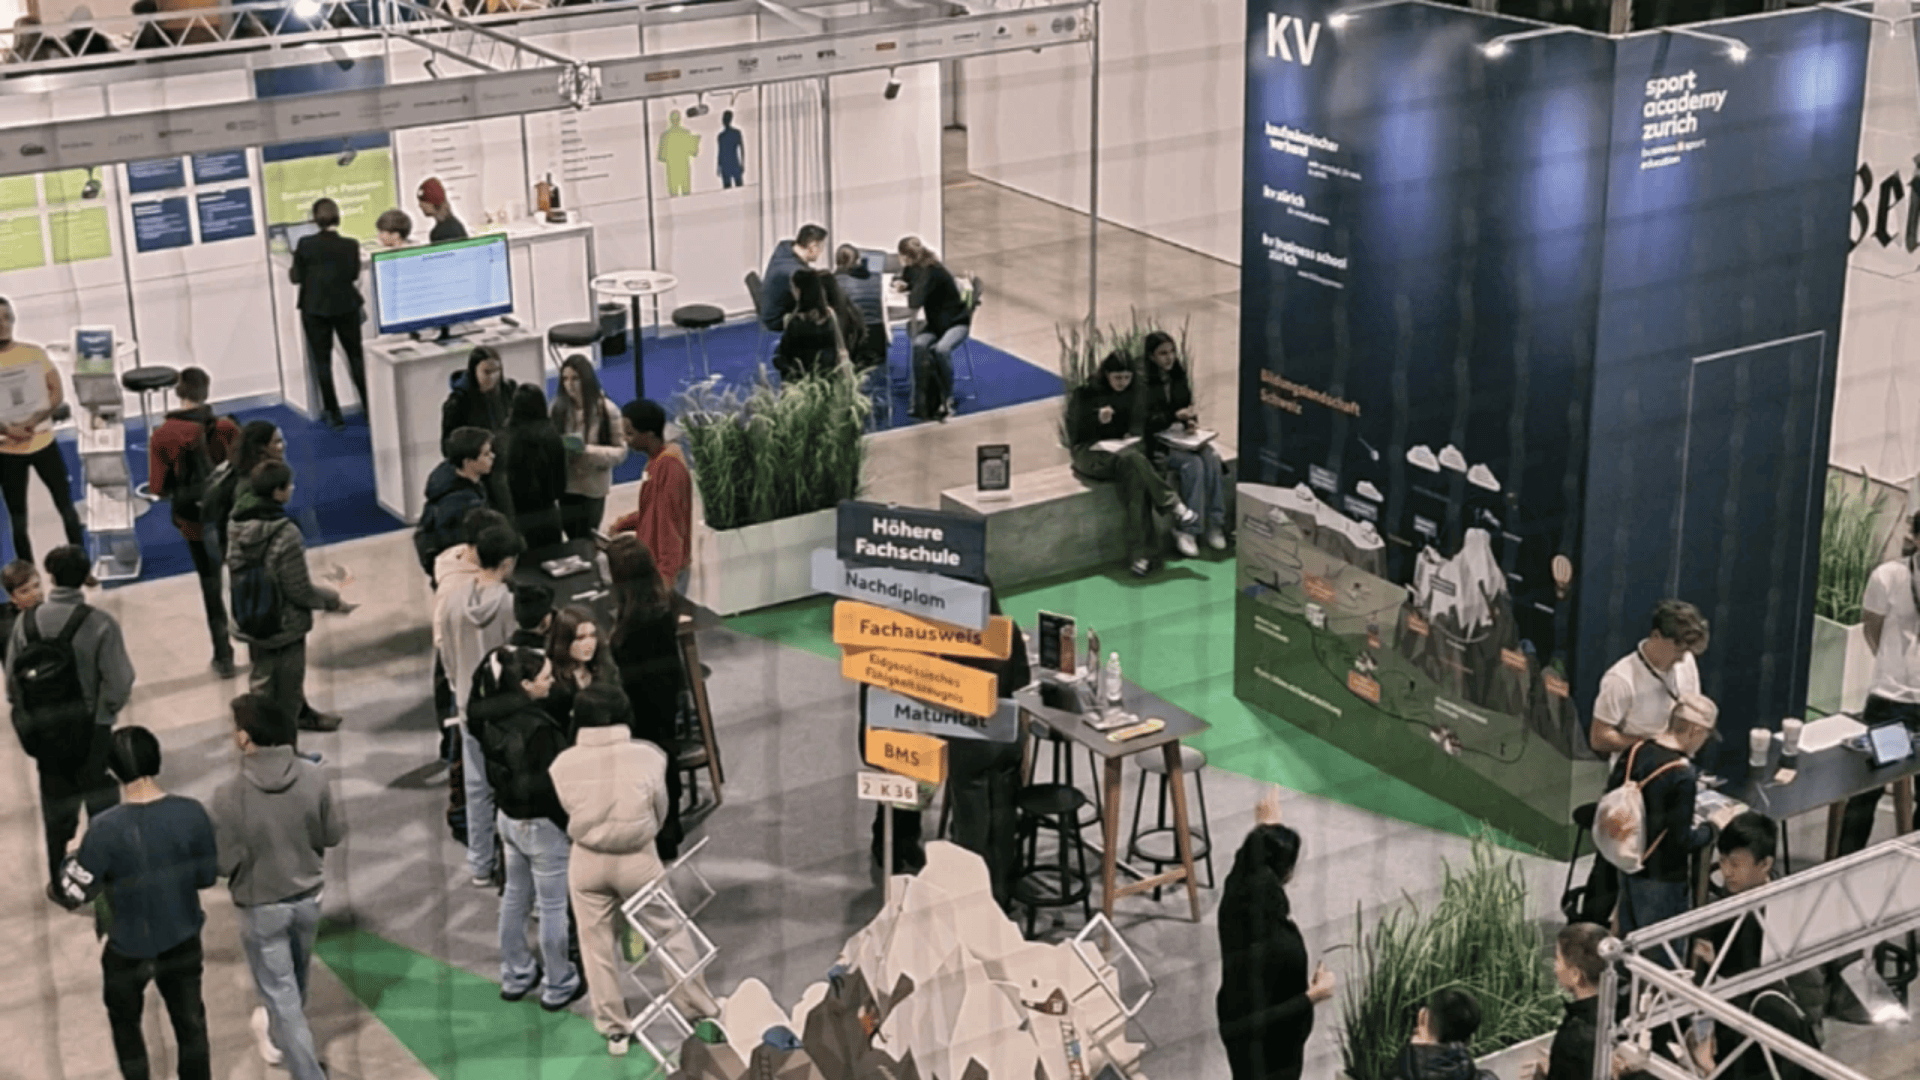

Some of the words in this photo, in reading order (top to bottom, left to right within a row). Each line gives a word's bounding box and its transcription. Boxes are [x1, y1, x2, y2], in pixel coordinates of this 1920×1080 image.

[1267, 12, 1320, 66] KV
[1645, 70, 1697, 99] sport
[1643, 90, 1727, 117] academy
[1642, 111, 1698, 140] zurich
[872, 517, 943, 541] Höhere
[855, 537, 961, 566] Fachschule
[845, 571, 946, 609] Nachdiplom
[860, 618, 982, 646] Fachausweis
[884, 742, 920, 767] BMS
[863, 780, 871, 795] 2
[881, 784, 890, 797] K
[895, 784, 913, 799] 36
